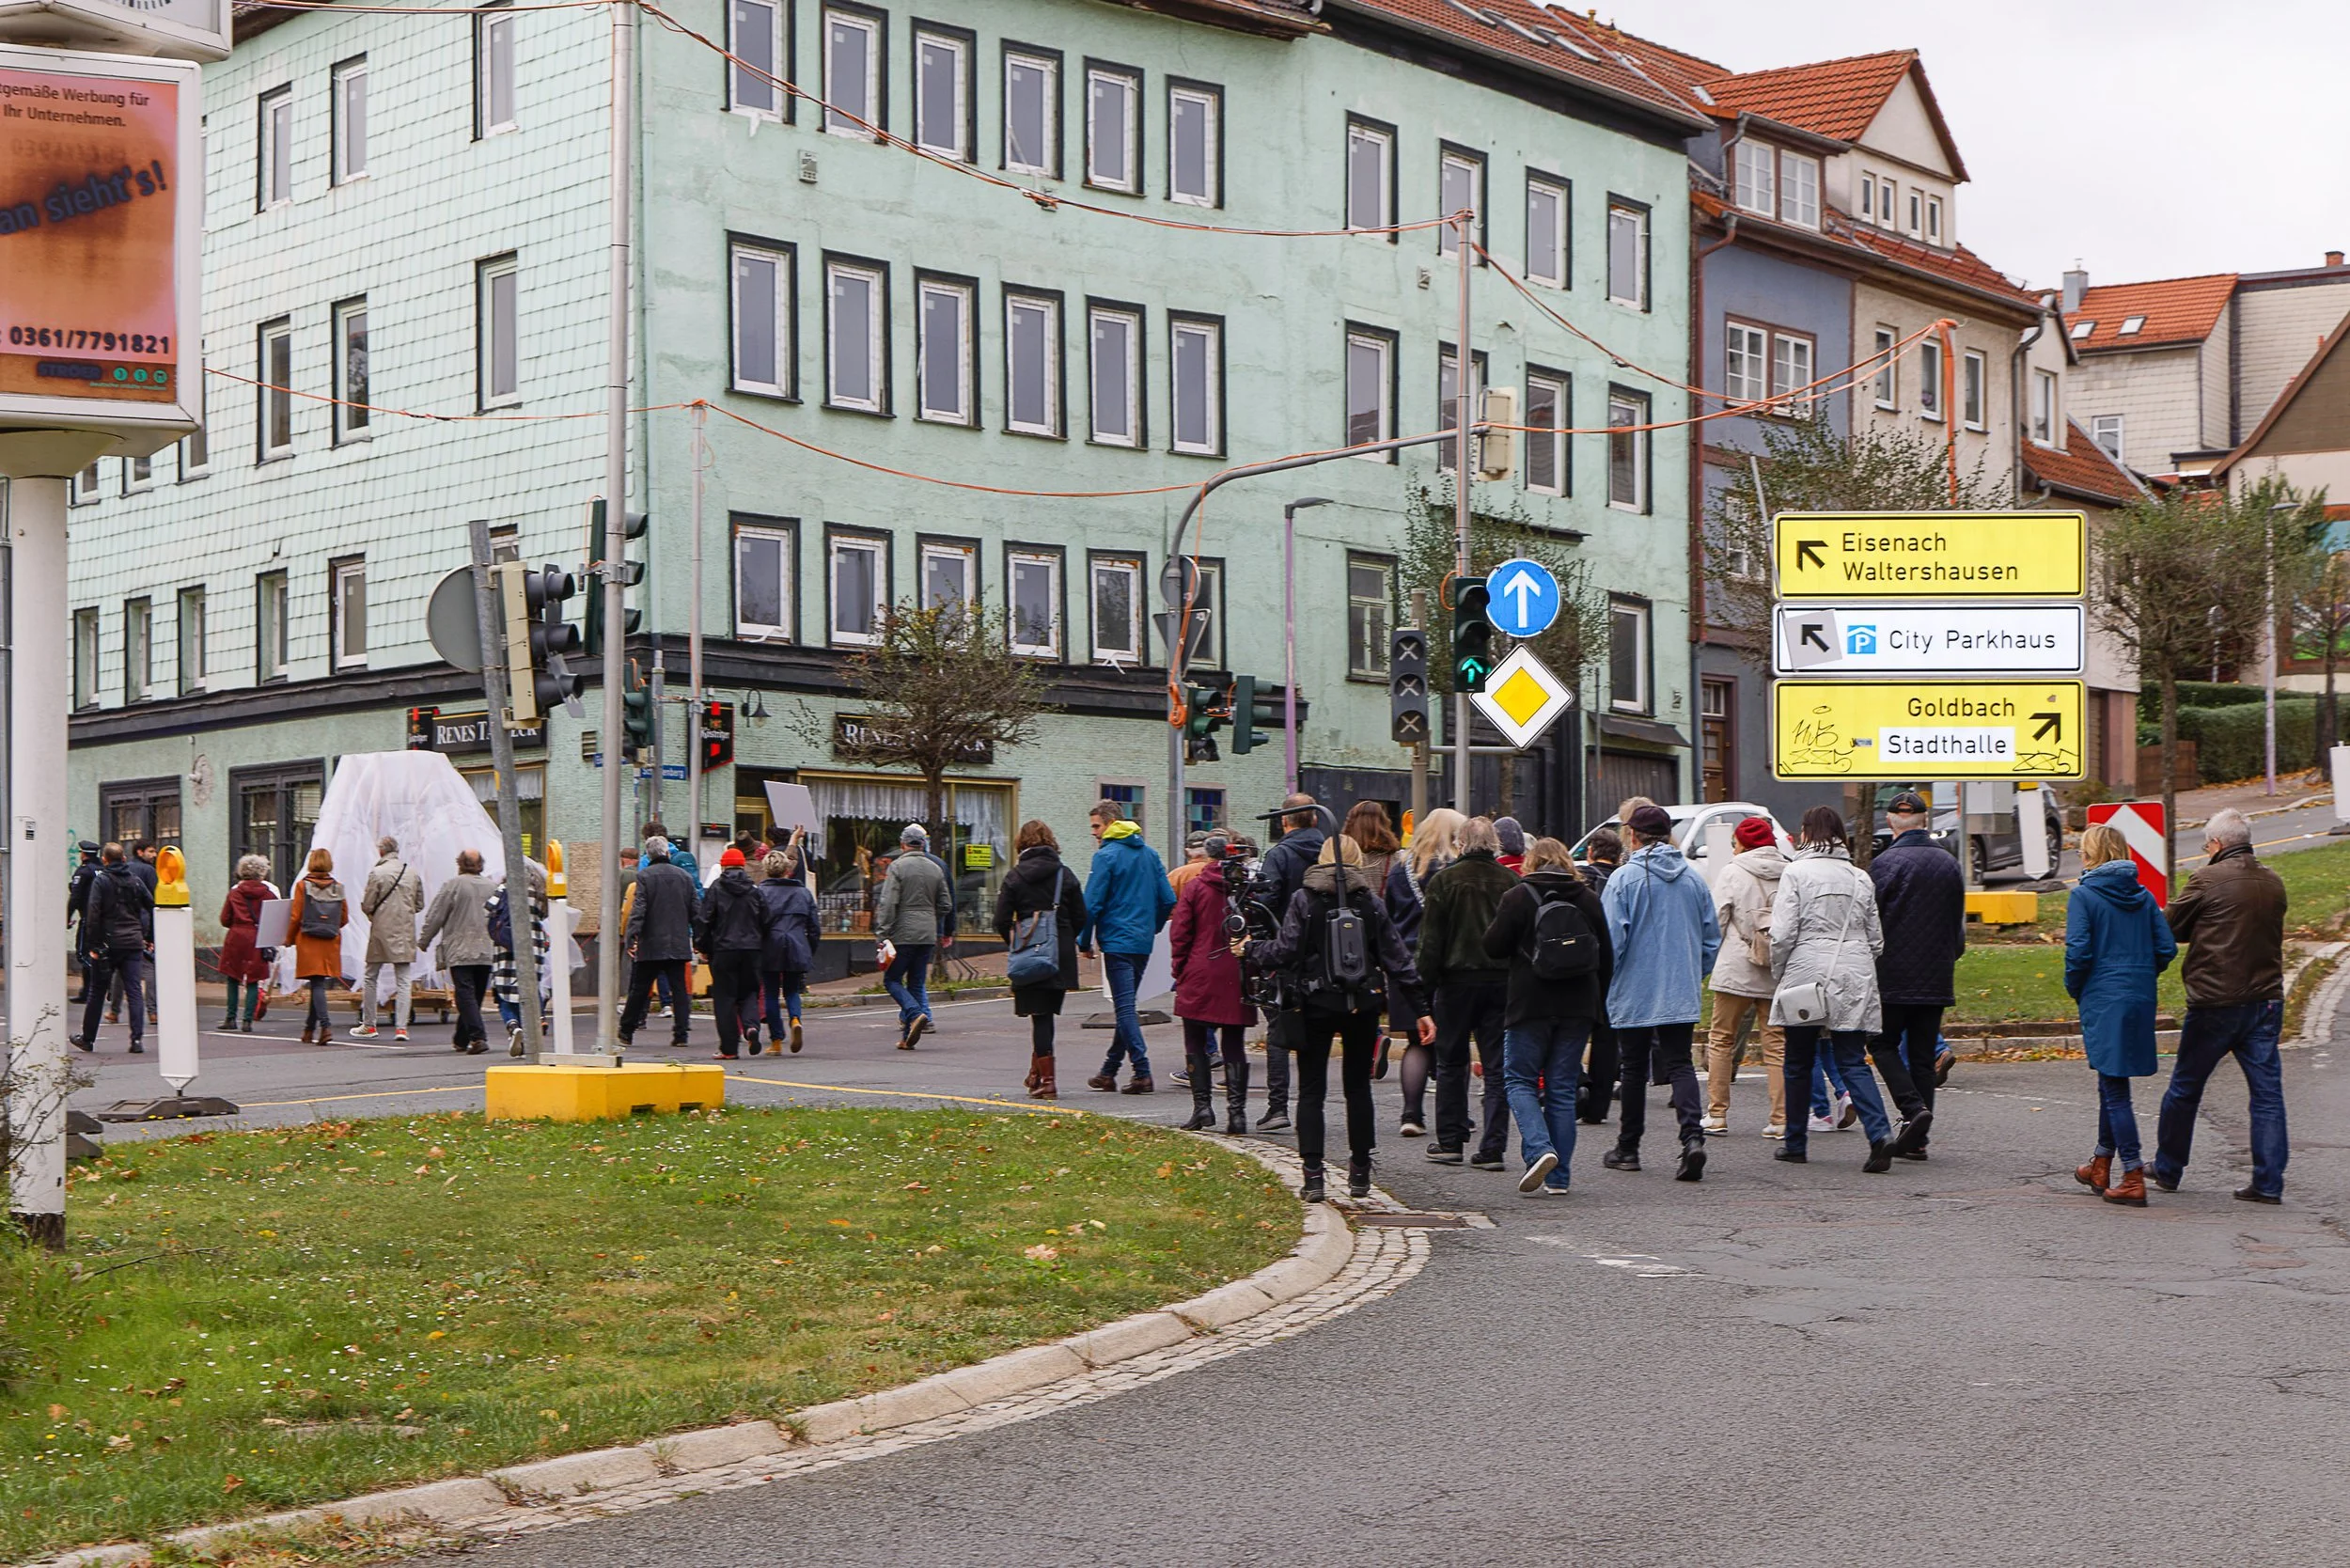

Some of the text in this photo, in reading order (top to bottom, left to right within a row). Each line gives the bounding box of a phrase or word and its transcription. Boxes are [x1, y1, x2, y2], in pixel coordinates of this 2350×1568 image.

[62, 87, 125, 107] Werbung
[130, 91, 150, 106] für
[4, 104, 127, 127] Ihr Unternehmen.
[45, 159, 167, 222] sieht's!
[9, 325, 169, 354] 0361/7791821
[1842, 532, 1947, 552] Eisenach
[1843, 561, 2019, 581] Waltershausen
[1888, 630, 1933, 653] City
[1946, 630, 2056, 649] Parkhaus
[1907, 698, 2015, 717] Goldbach
[436, 724, 476, 745] RENES
[1888, 735, 2006, 754] Stadthalle
